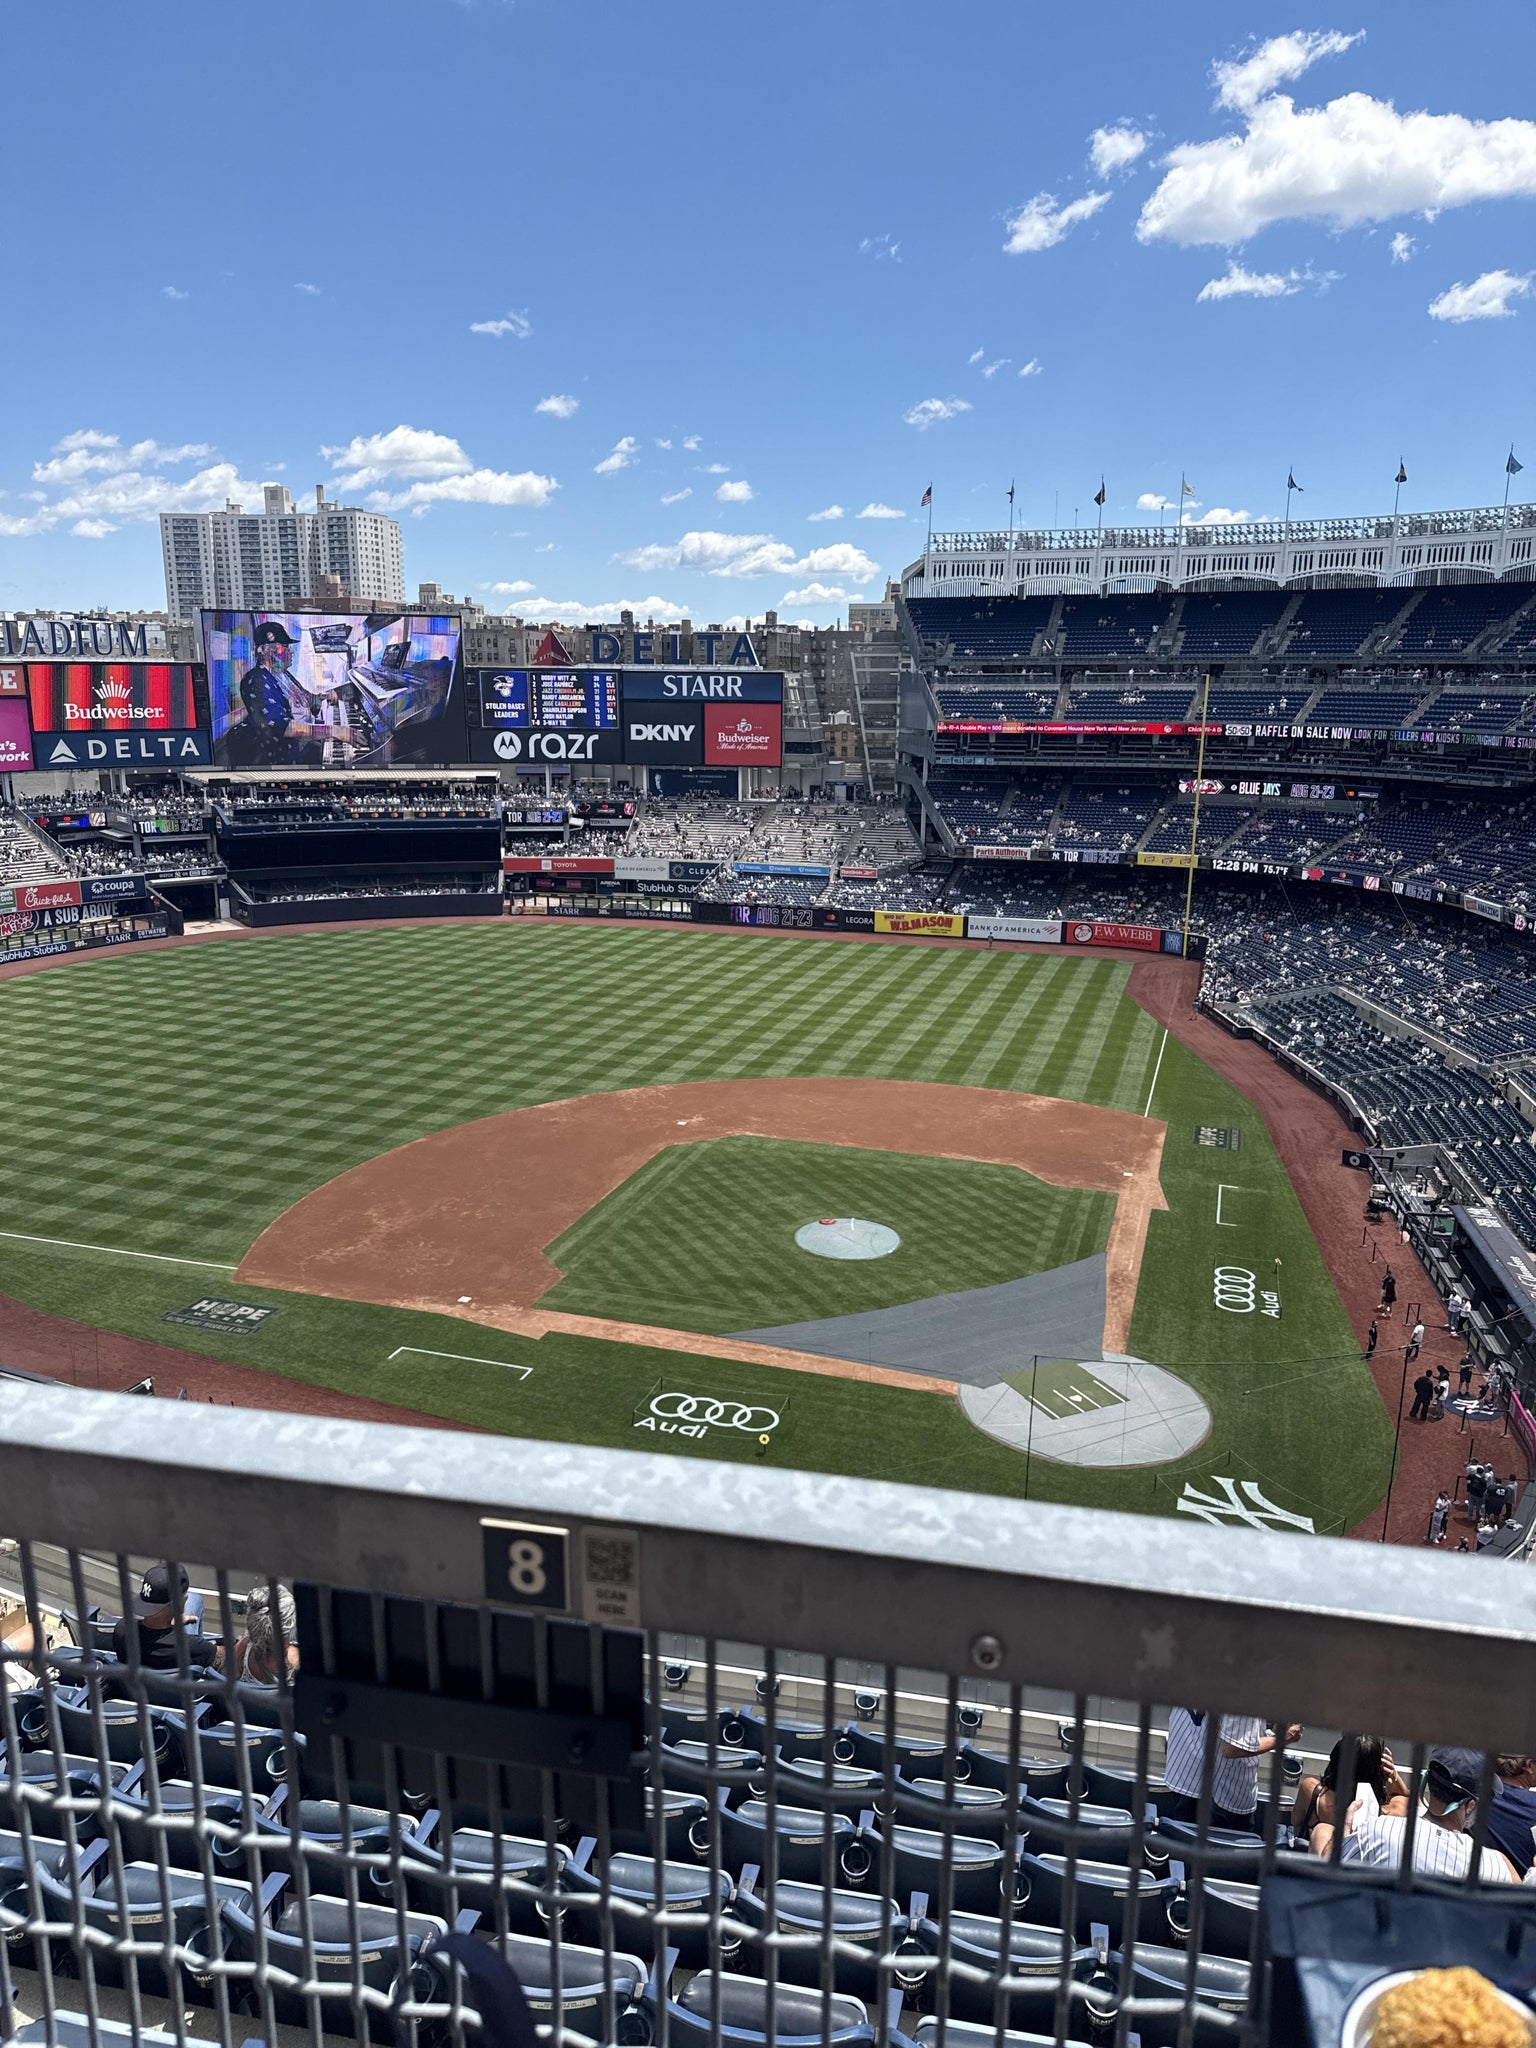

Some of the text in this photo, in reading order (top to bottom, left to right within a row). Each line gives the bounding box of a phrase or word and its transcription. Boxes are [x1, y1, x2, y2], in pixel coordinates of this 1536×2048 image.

[592, 633, 761, 666] DELTA
[662, 675, 743, 697] STARR
[64, 703, 162, 719] Budweiser
[630, 723, 696, 742] DKNY
[718, 732, 770, 743] Budweiser
[1255, 725, 1515, 748] RAFFLE ON SALE NOW LOOK FOR SELLERS AND KIOSKS THROUGHOUT THE
[87, 737, 200, 760] DELTA
[528, 733, 599, 759] razr
[716, 742, 736, 750] Made
[1239, 782, 1335, 799] BLUE JAYS AUG 21-23
[507, 812, 522, 823] TOR
[140, 821, 157, 834] TOR
[162, 819, 179, 833] AUG
[994, 848, 1028, 857] Authority
[1064, 851, 1078, 862] TOR
[1212, 859, 1258, 873] 12:28 PM
[1263, 864, 1288, 875] 75.7°F
[104, 880, 135, 890] coupa
[638, 883, 674, 892] StubHub
[1392, 881, 1404, 894] TOR
[25, 887, 73, 907] Chick-fil-A
[44, 902, 119, 926] A SUB ABOVE
[729, 906, 812, 926] TOR AUG 21-23
[890, 916, 953, 931] W.B.MASON
[105, 932, 131, 943] STARR
[138, 928, 166, 936] CUTWATER
[1119, 928, 1153, 940] WEBB
[0, 944, 67, 962] StubHub StubHub
[192, 1300, 270, 1320] HOPE
[1260, 1291, 1280, 1318] Audi
[634, 1417, 708, 1438] Audi
[508, 1540, 546, 1594] 8
[142, 1582, 152, 1598] NY
[596, 1588, 627, 1602] SCAN
[598, 1602, 626, 1616] HERE
